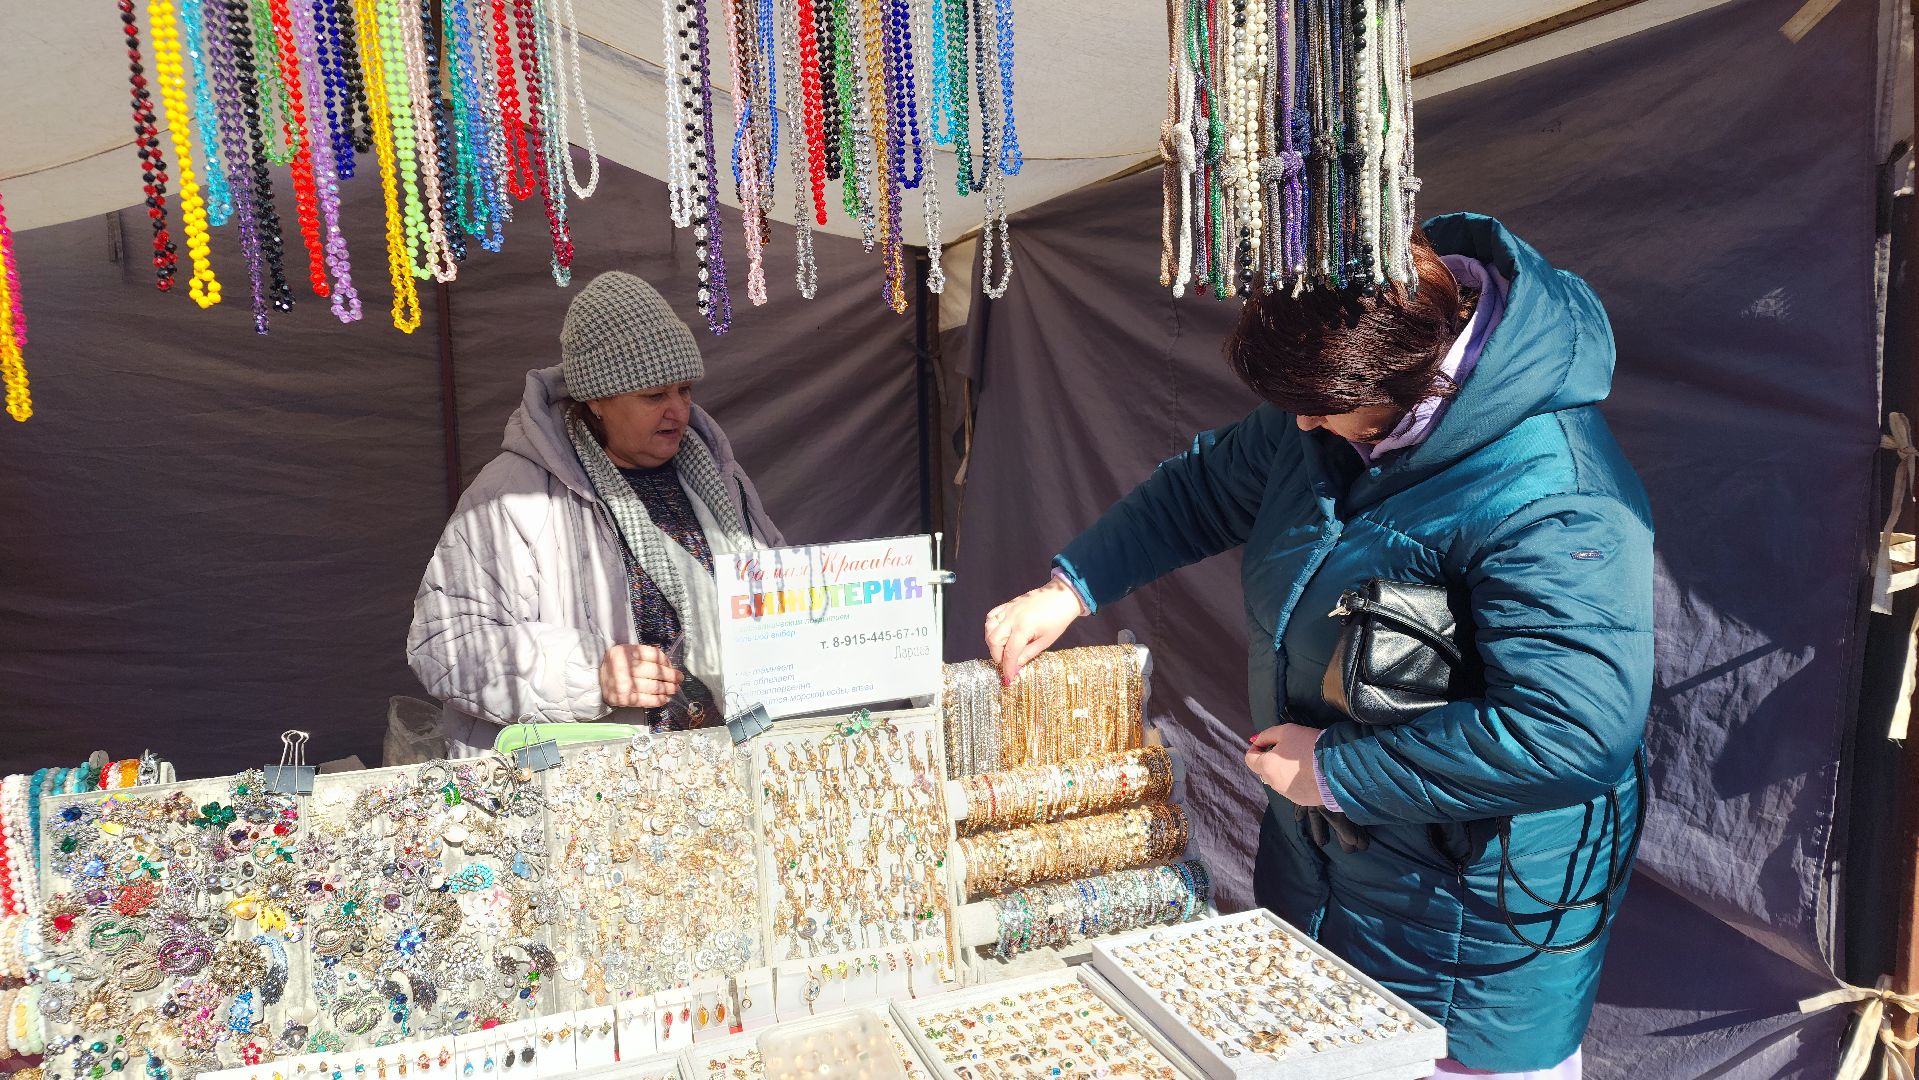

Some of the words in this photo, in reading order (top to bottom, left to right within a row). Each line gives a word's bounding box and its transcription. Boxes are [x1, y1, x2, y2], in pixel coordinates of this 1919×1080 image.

[820, 547, 913, 582] Красивая
[730, 577, 923, 619] БИЖУТЕРИЯ
[736, 632, 769, 645] льшой
[771, 629, 796, 640] выбор
[832, 626, 929, 648] 8-915-445-67-10
[894, 645, 930, 661] Лариса
[740, 682, 811, 698] поаллергенно
[789, 689, 825, 702] морской
